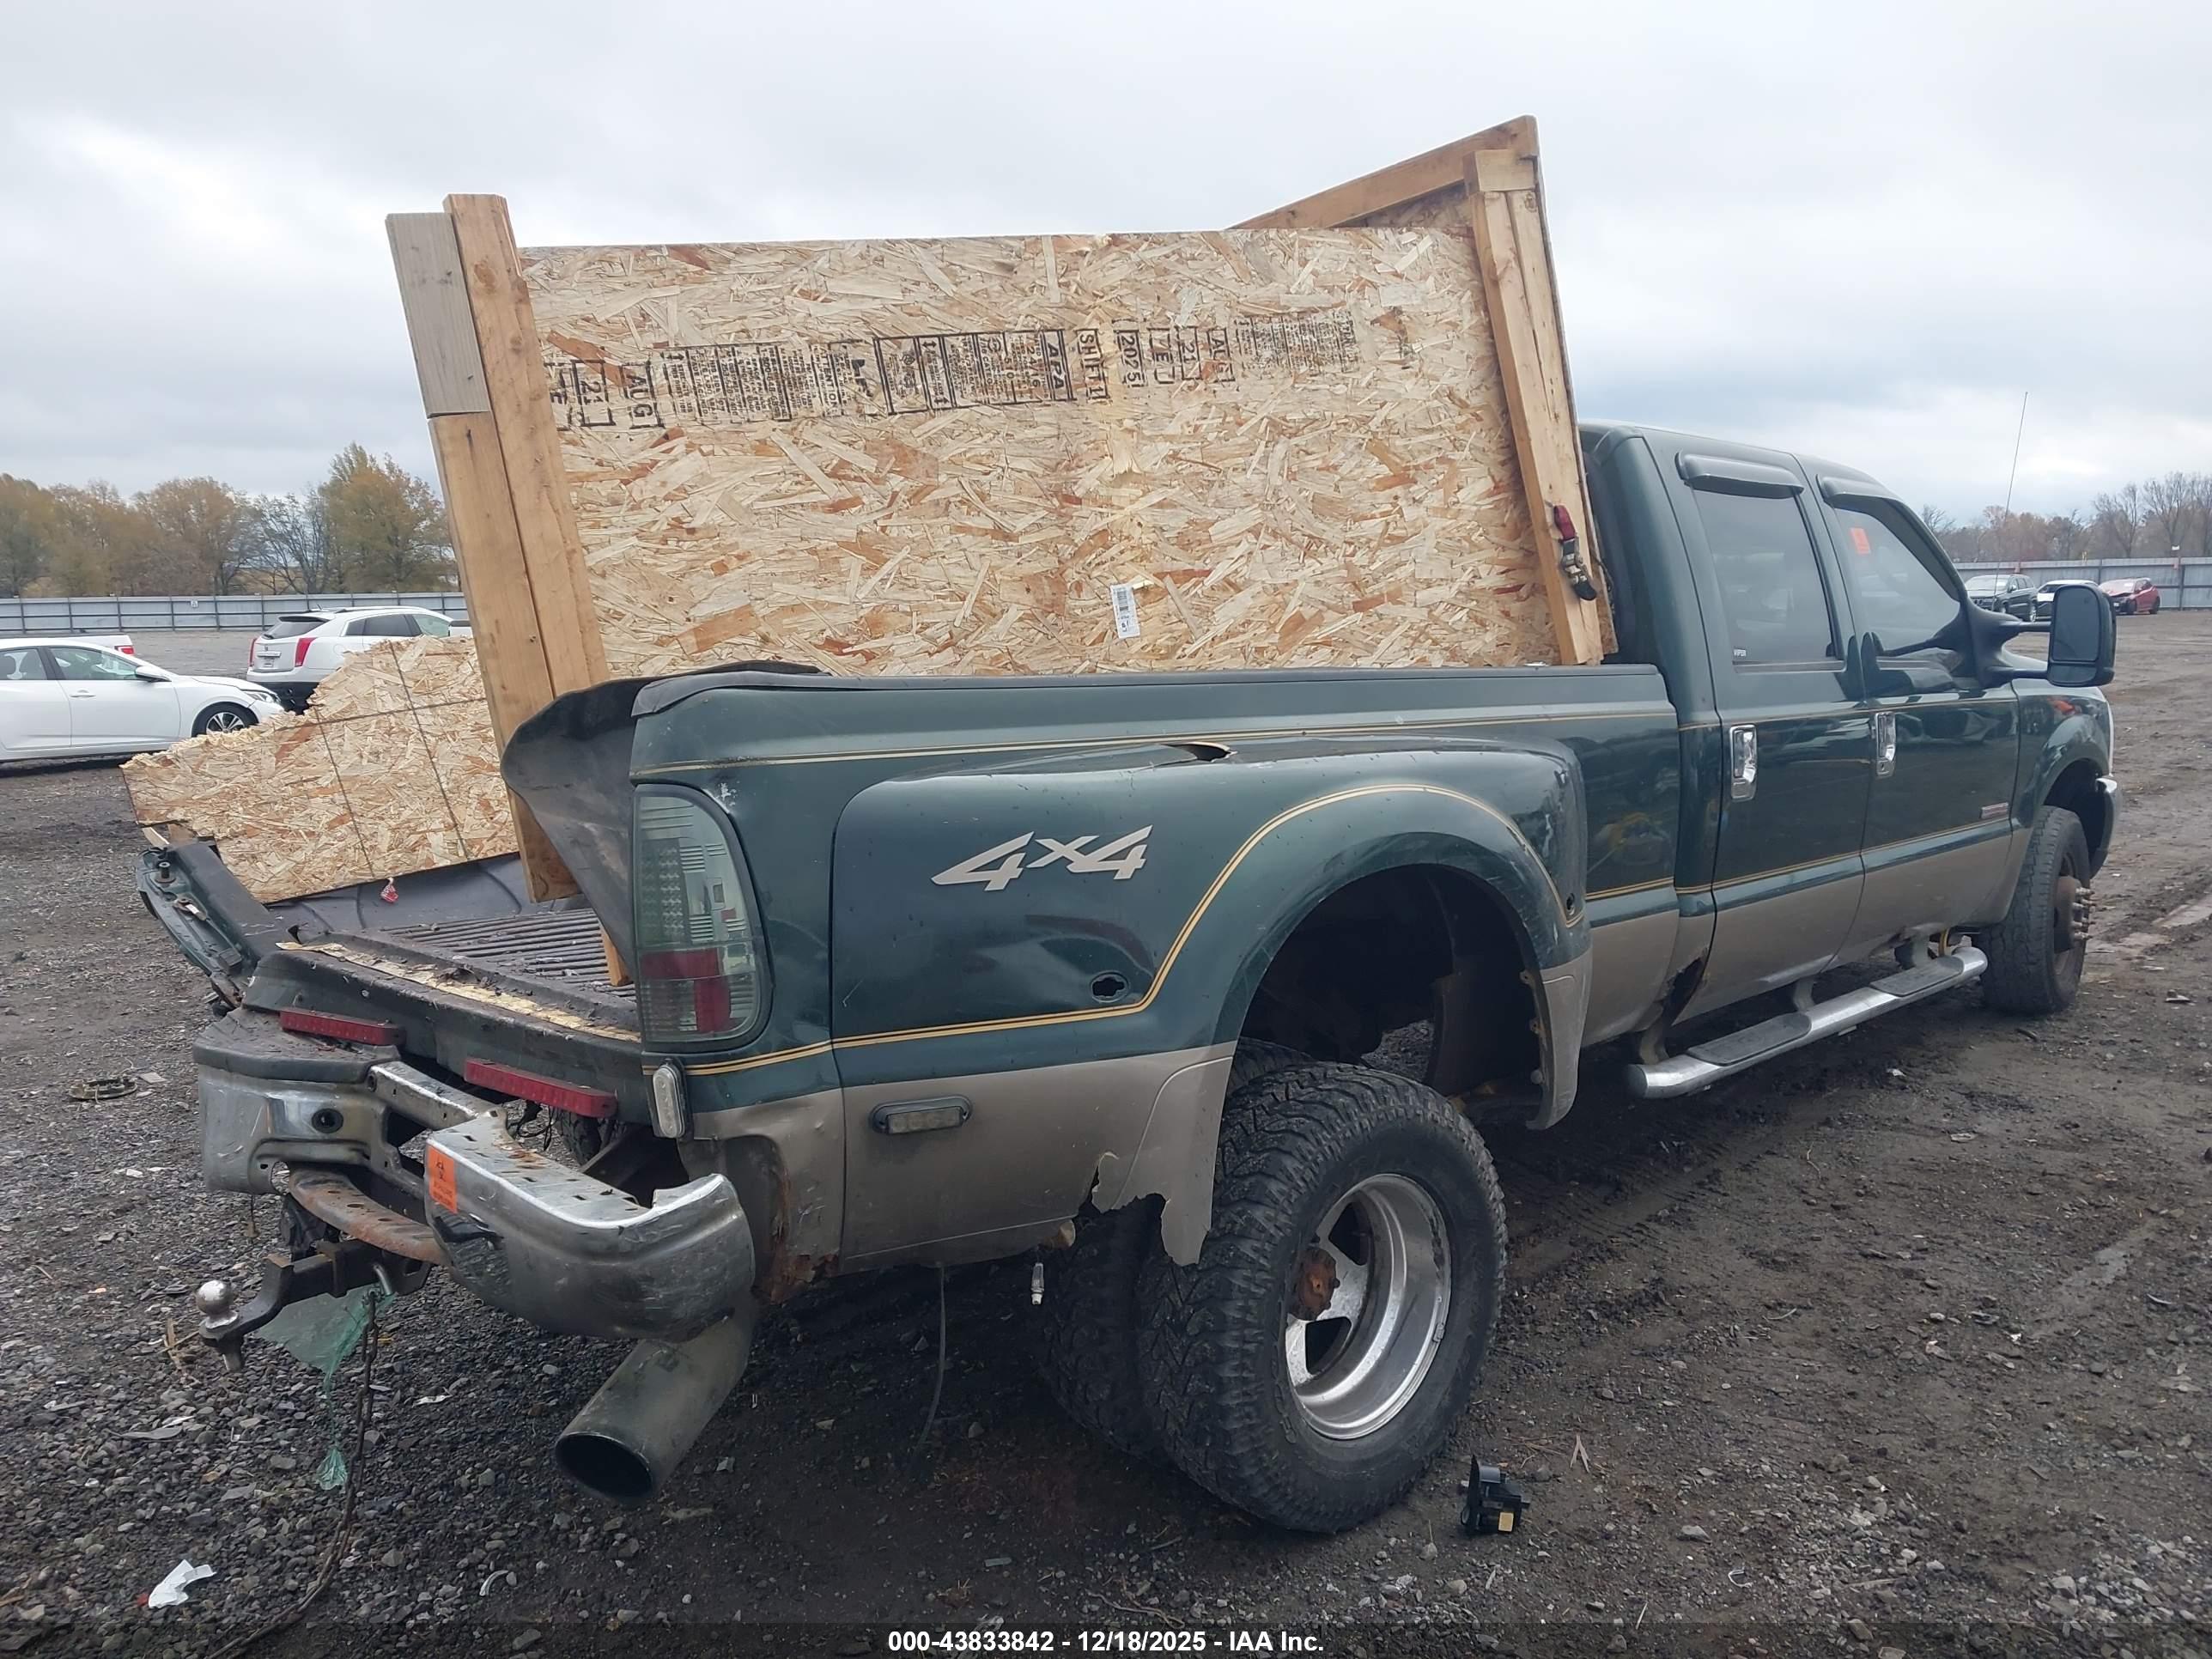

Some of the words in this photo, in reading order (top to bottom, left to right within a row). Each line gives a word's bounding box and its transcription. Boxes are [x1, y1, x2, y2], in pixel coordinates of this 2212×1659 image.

[1003, 358, 1014, 379] 510
[1025, 346, 1041, 387] 24/16
[1047, 342, 1064, 388] APA
[1120, 335, 1142, 381] 2025
[1181, 343, 1197, 363] 21
[580, 379, 604, 404] 21
[626, 373, 653, 417] AUG
